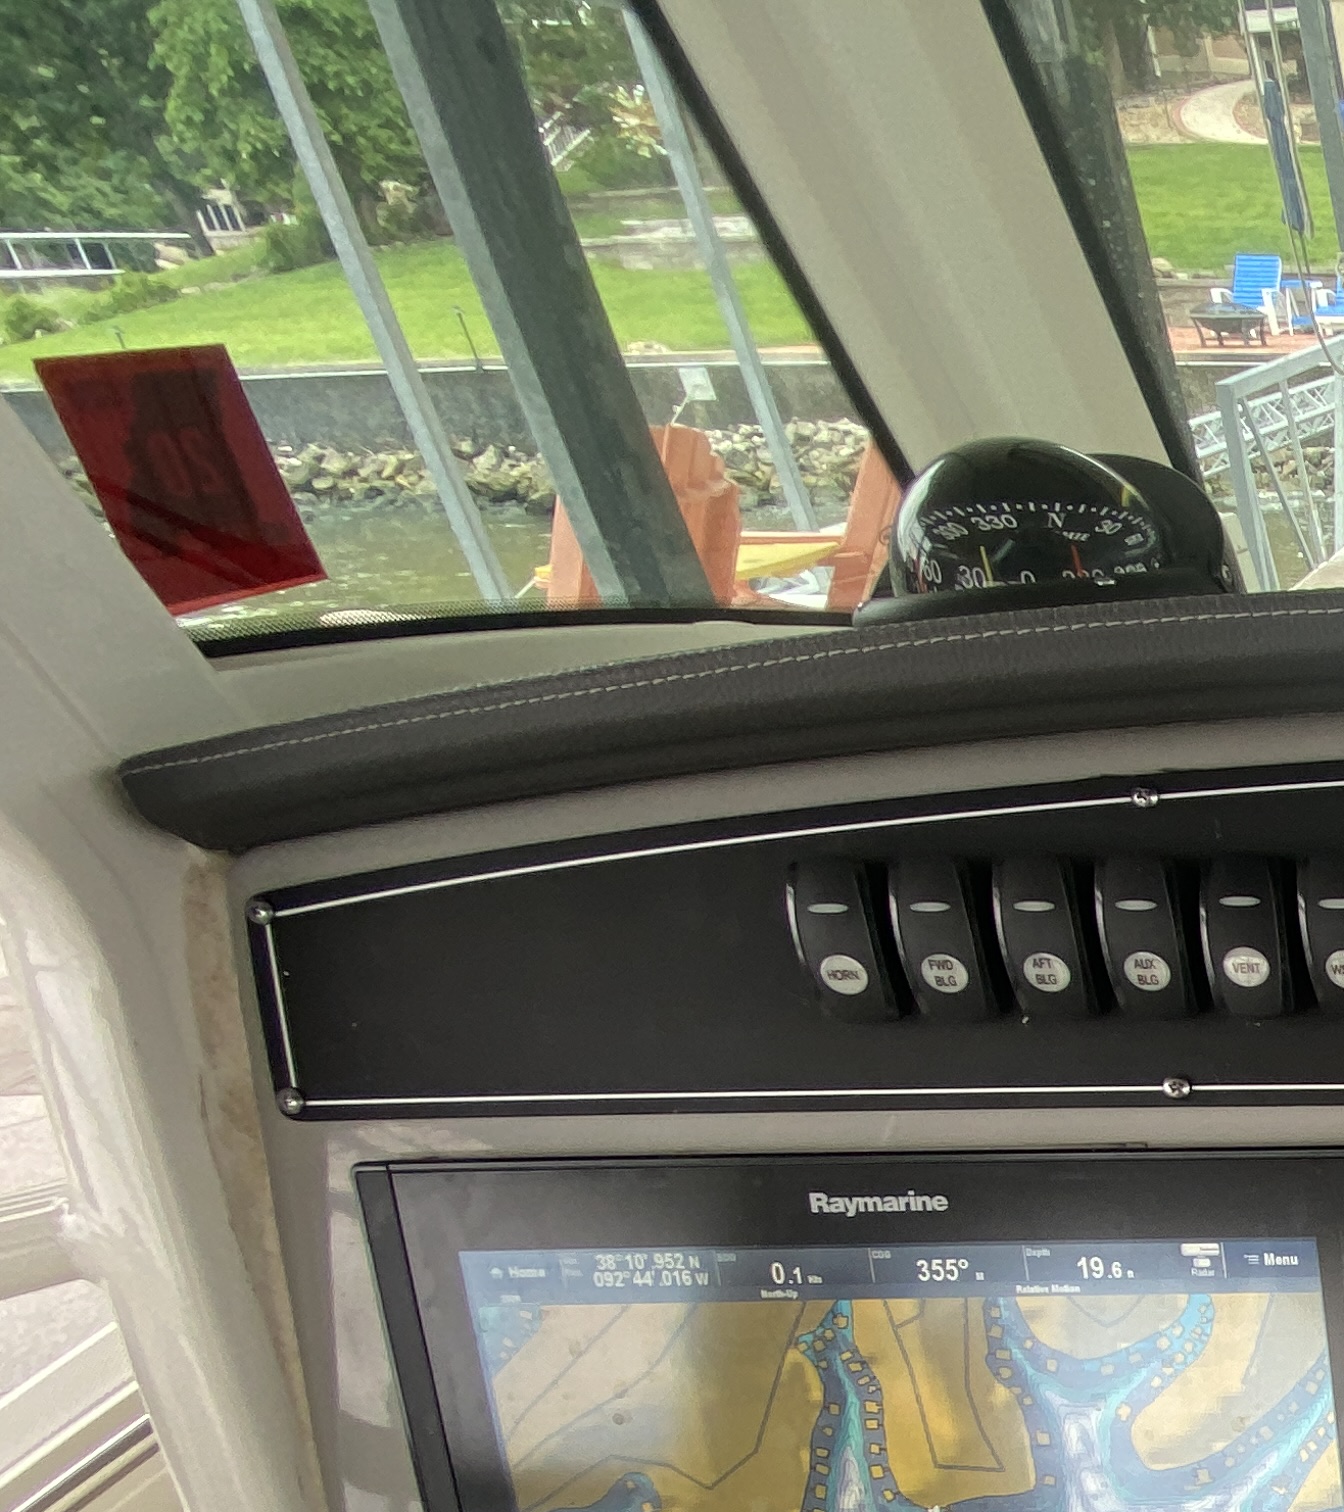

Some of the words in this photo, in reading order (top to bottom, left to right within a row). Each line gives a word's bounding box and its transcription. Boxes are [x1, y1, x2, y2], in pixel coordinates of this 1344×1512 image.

[971, 514, 1018, 531] 330
[1047, 512, 1067, 529] N
[927, 958, 954, 972] FWD
[1031, 957, 1053, 970] AFT
[1133, 958, 1157, 971] AUX
[1231, 962, 1261, 975] VENT
[934, 974, 958, 988] BLG
[1035, 973, 1058, 986] BLG
[1137, 974, 1160, 987] BLG
[808, 1190, 949, 1218] Raymarine
[689, 1255, 701, 1269] N
[1263, 1252, 1299, 1266] Menu
[770, 1261, 803, 1285] 0.1
[916, 1259, 969, 1282] 355°
[1076, 1256, 1123, 1280] 19.6
[695, 1272, 709, 1286] W
